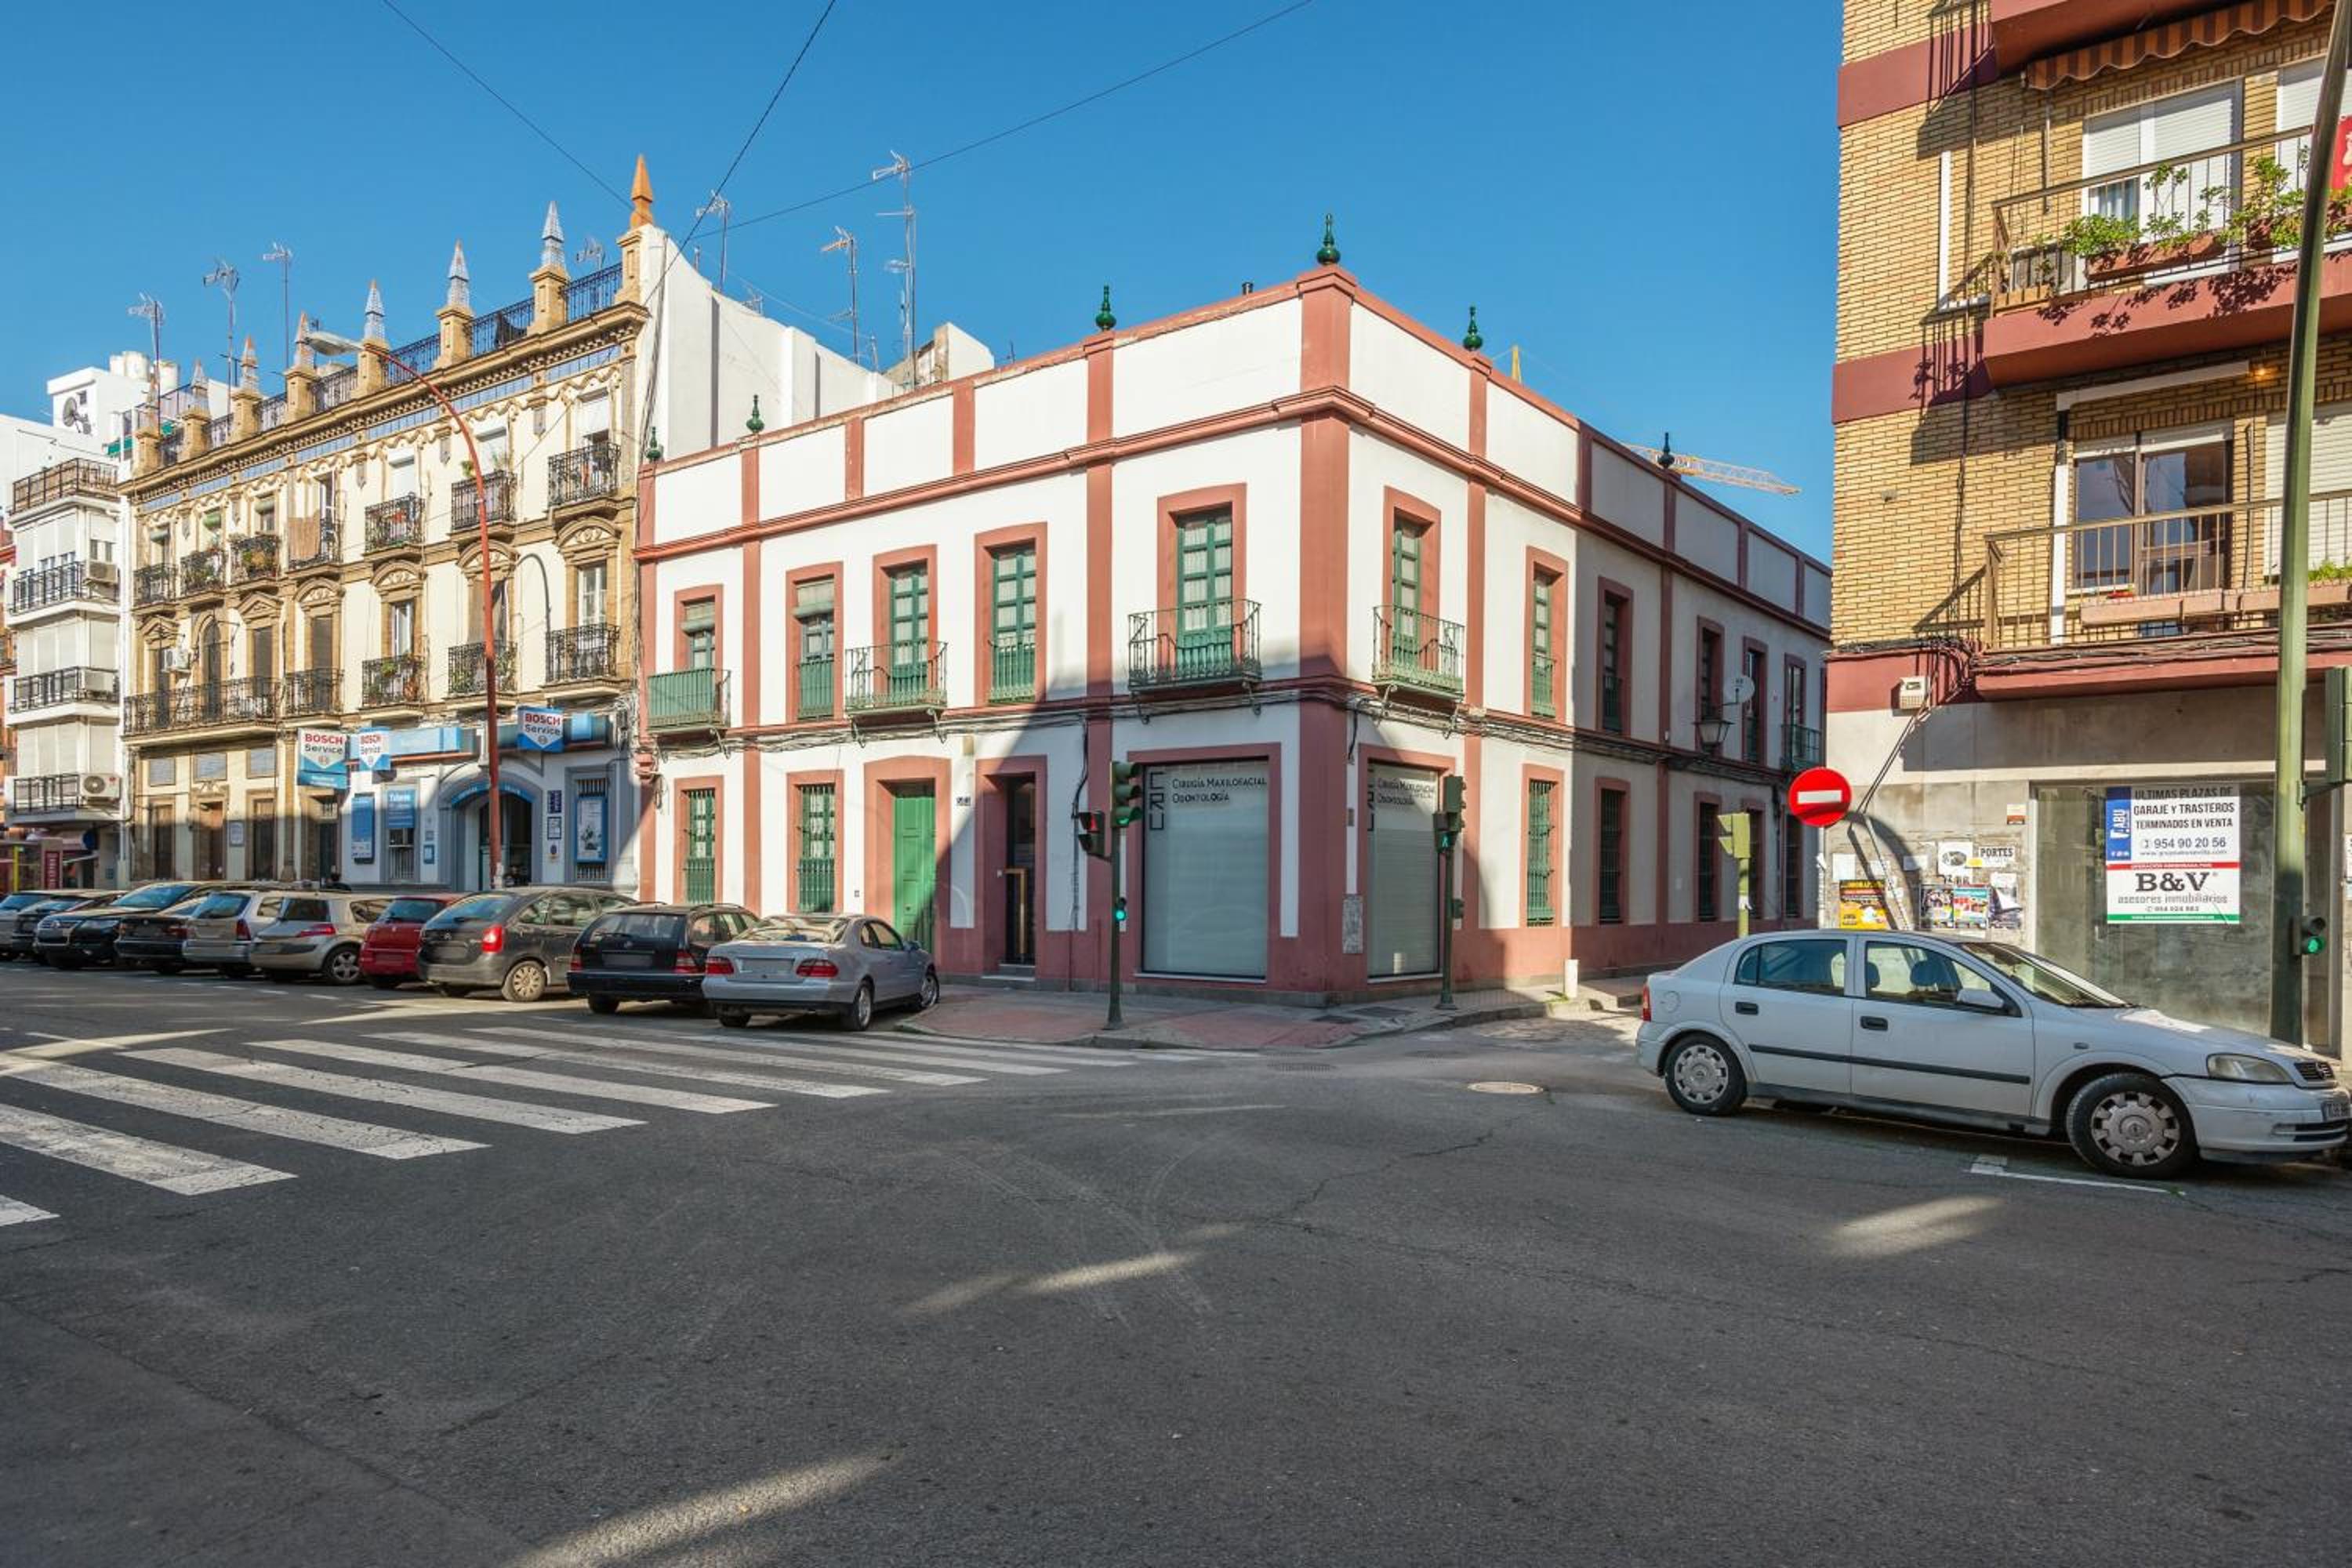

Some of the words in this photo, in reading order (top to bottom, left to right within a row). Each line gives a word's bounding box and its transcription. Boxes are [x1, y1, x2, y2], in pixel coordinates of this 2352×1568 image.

[525, 713, 561, 725] BOSCH
[525, 724, 561, 735] Service
[305, 734, 343, 744] BOSCH
[305, 744, 343, 754] Service
[2180, 787, 2217, 799] PLAZAS
[2220, 786, 2233, 797] DE
[2133, 804, 2169, 816] GARAJE
[2172, 805, 2177, 815] Y
[2180, 803, 2235, 815] TRASTEROS
[2136, 819, 2189, 829] TERMINADOS
[2191, 818, 2202, 829] EN
[2205, 818, 2233, 828] VENTA
[2154, 838, 2175, 848] 954
[2177, 837, 2192, 848] 90
[2195, 837, 2209, 848] 20
[1980, 848, 2013, 857] PORTES
[2135, 872, 2209, 892] B&V
[2118, 895, 2161, 904] asesores
[2165, 892, 2227, 904] inmobiliarios
